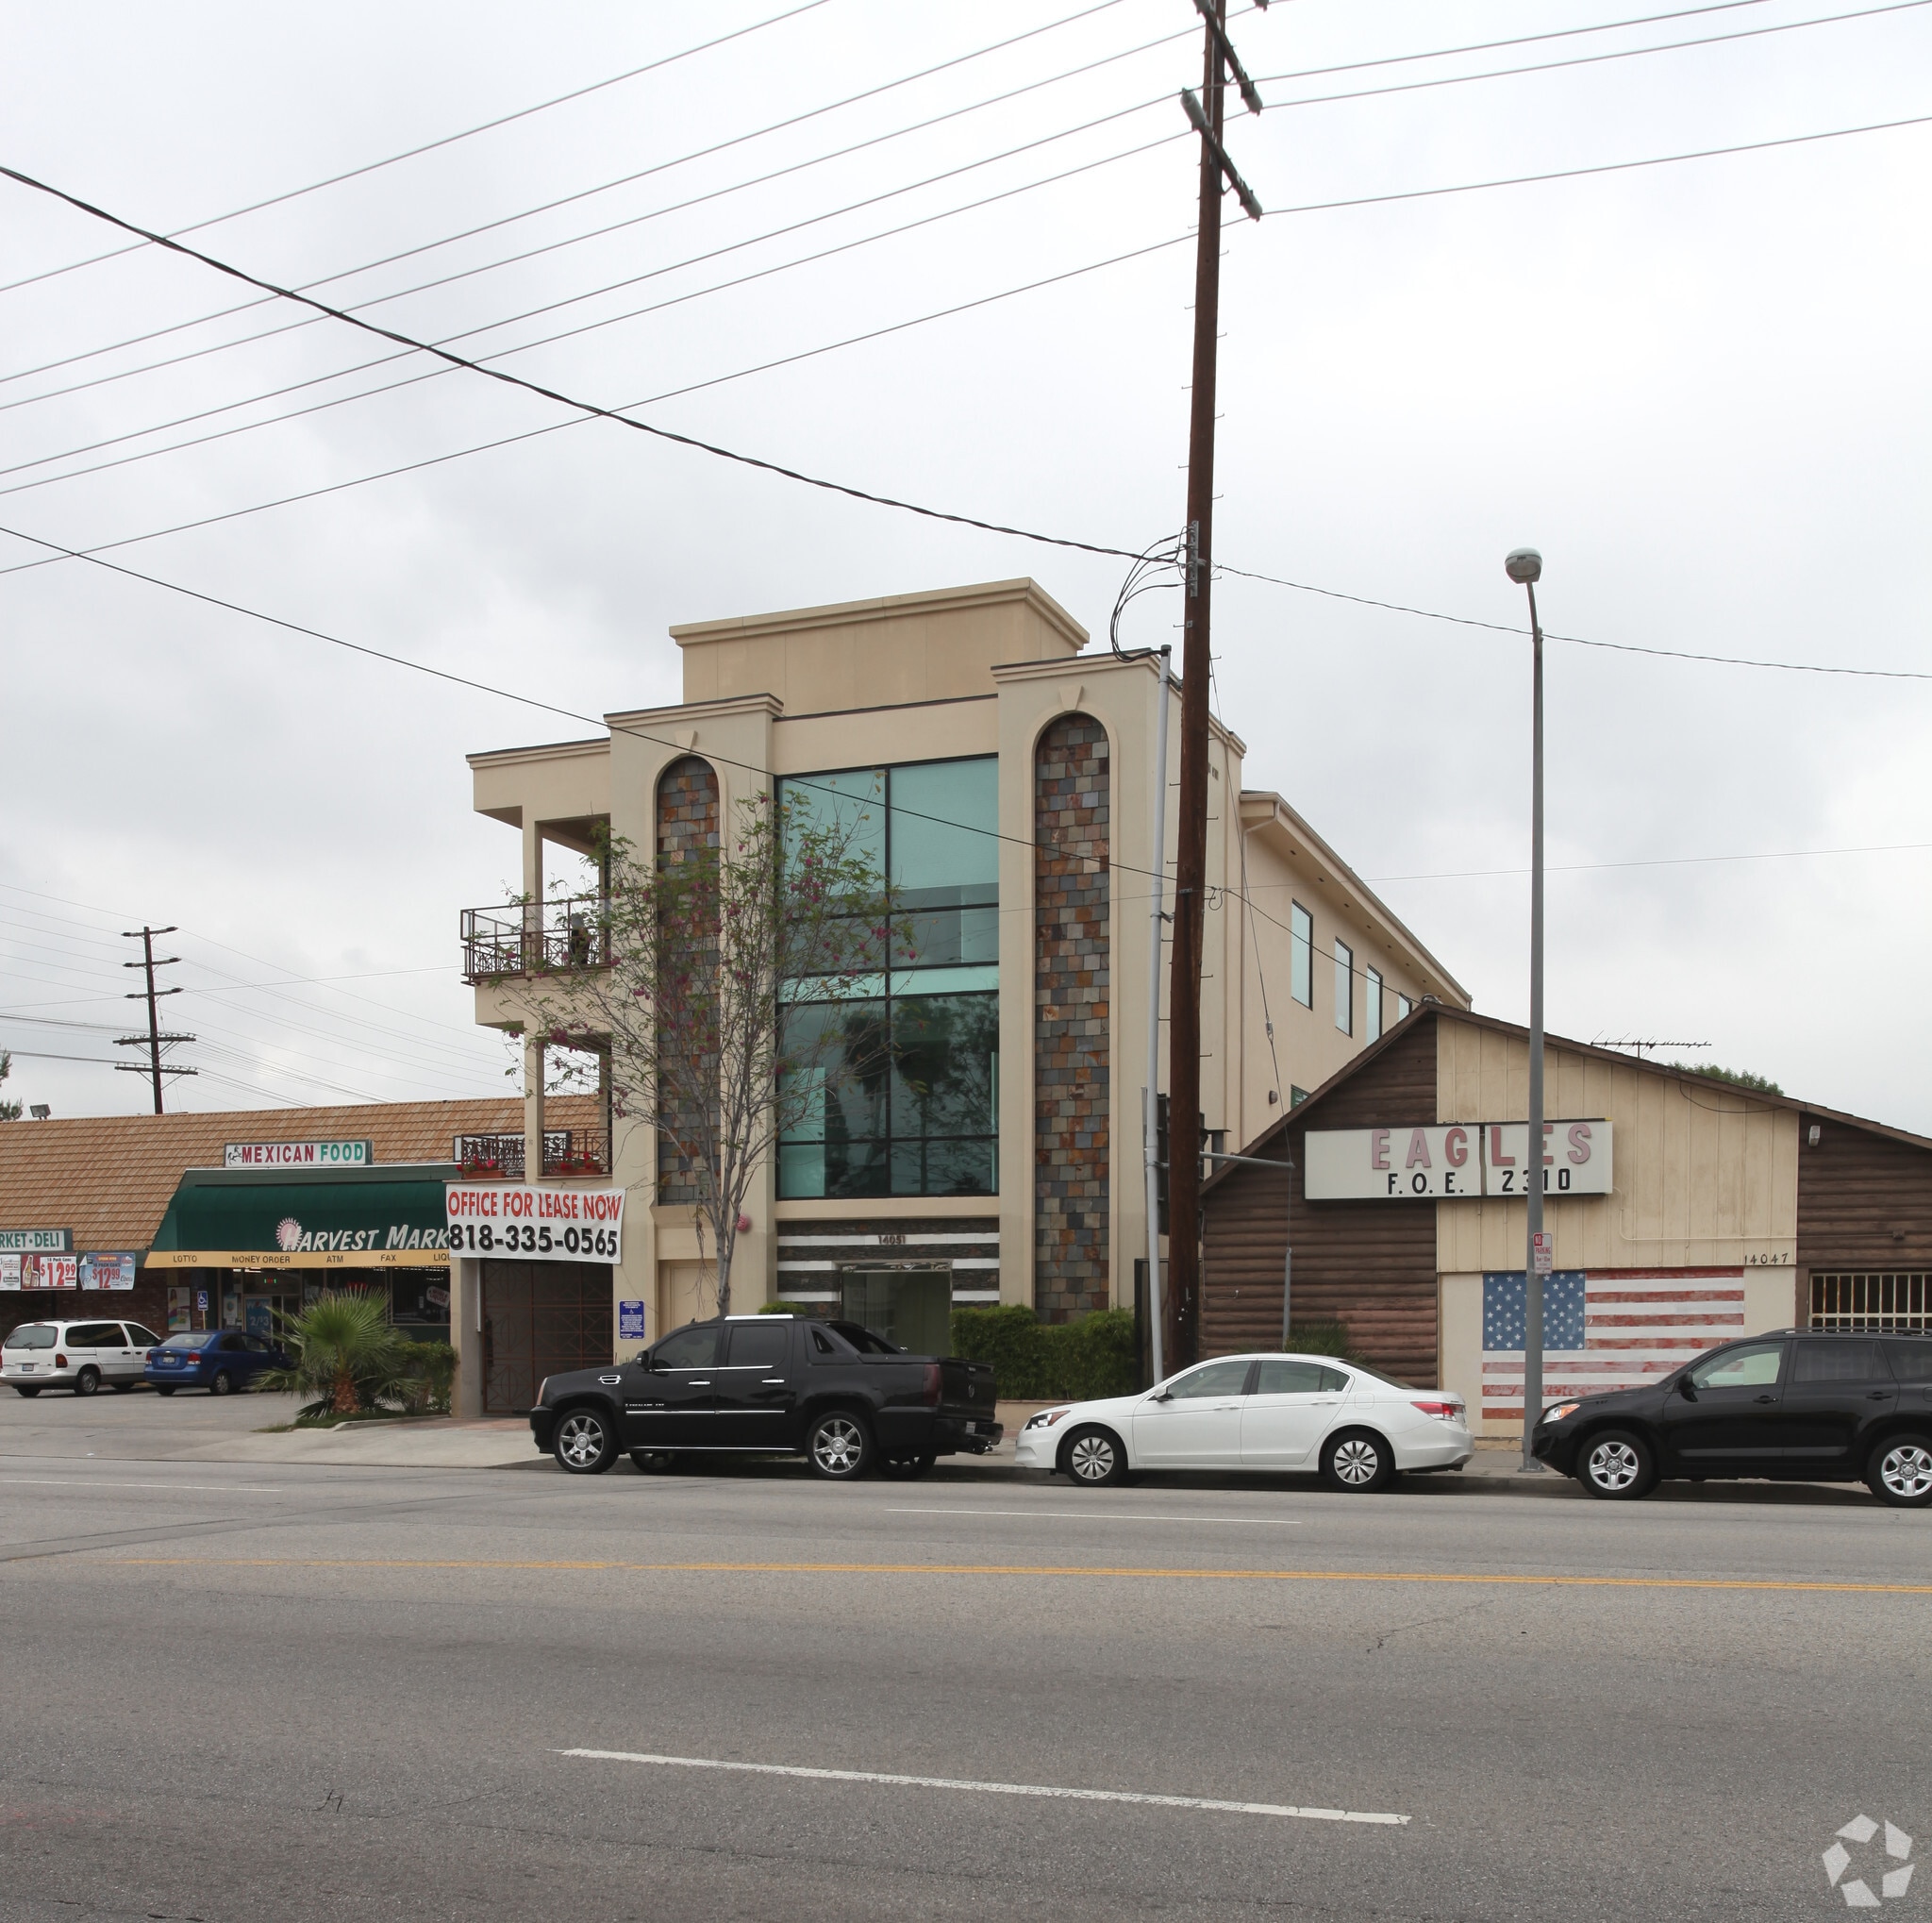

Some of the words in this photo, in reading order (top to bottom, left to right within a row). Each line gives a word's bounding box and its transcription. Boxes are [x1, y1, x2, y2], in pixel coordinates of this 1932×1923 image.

[242, 1145, 314, 1163] MEXICAN
[320, 1144, 363, 1162] FOOD
[1372, 1123, 1591, 1169] EAGLES
[448, 1191, 497, 1217] OFFICE
[503, 1192, 533, 1217] FOR
[539, 1193, 578, 1219] LEASE
[583, 1195, 622, 1221] NOW
[34, 1231, 59, 1248] DELI
[282, 1226, 379, 1252] HARVEST
[449, 1224, 618, 1257] 818-335-0565
[877, 1234, 906, 1246] 14051
[173, 1254, 197, 1263] LOTTO
[231, 1255, 260, 1264] MONEY
[262, 1255, 291, 1264] ORDER
[326, 1254, 344, 1263] ATM
[380, 1253, 396, 1262] FAX
[1744, 1252, 1789, 1265] 14047
